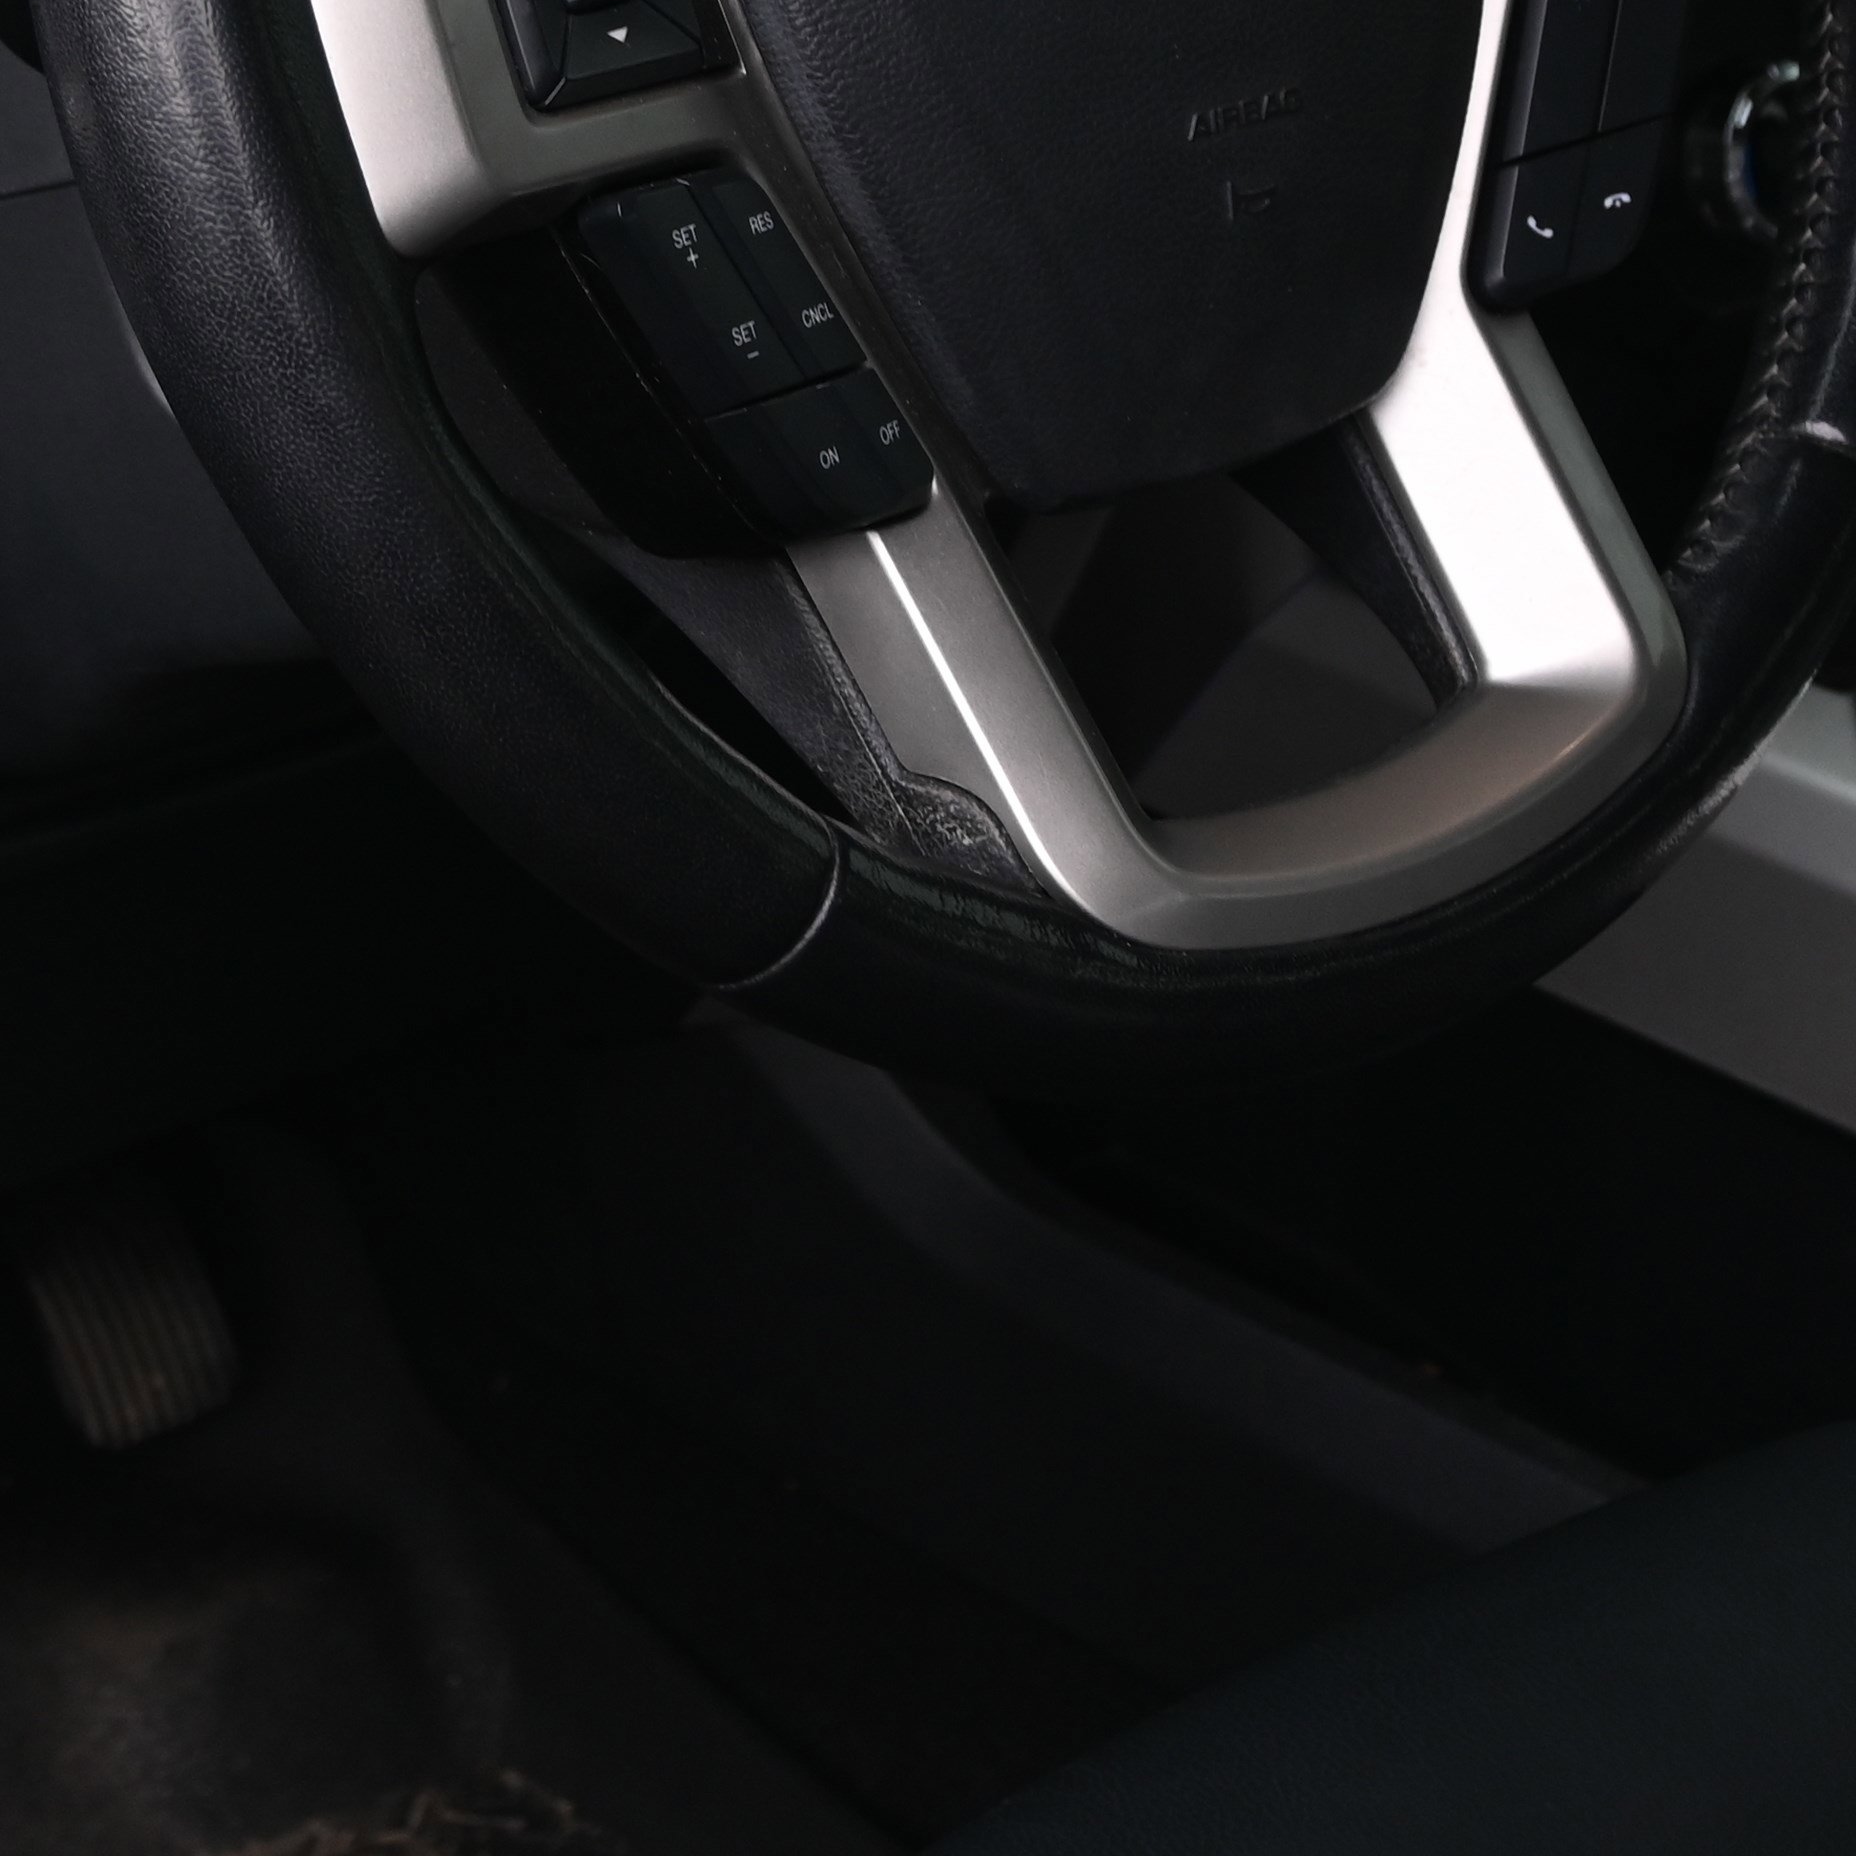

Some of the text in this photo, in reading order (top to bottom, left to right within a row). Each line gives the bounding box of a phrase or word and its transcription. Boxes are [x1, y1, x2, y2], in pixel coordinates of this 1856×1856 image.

[749, 210, 775, 236] RES
[672, 223, 698, 250] SET
[801, 301, 835, 329] CNCL
[731, 321, 757, 347] SET
[879, 419, 902, 446] OFF
[819, 446, 841, 471] ON
